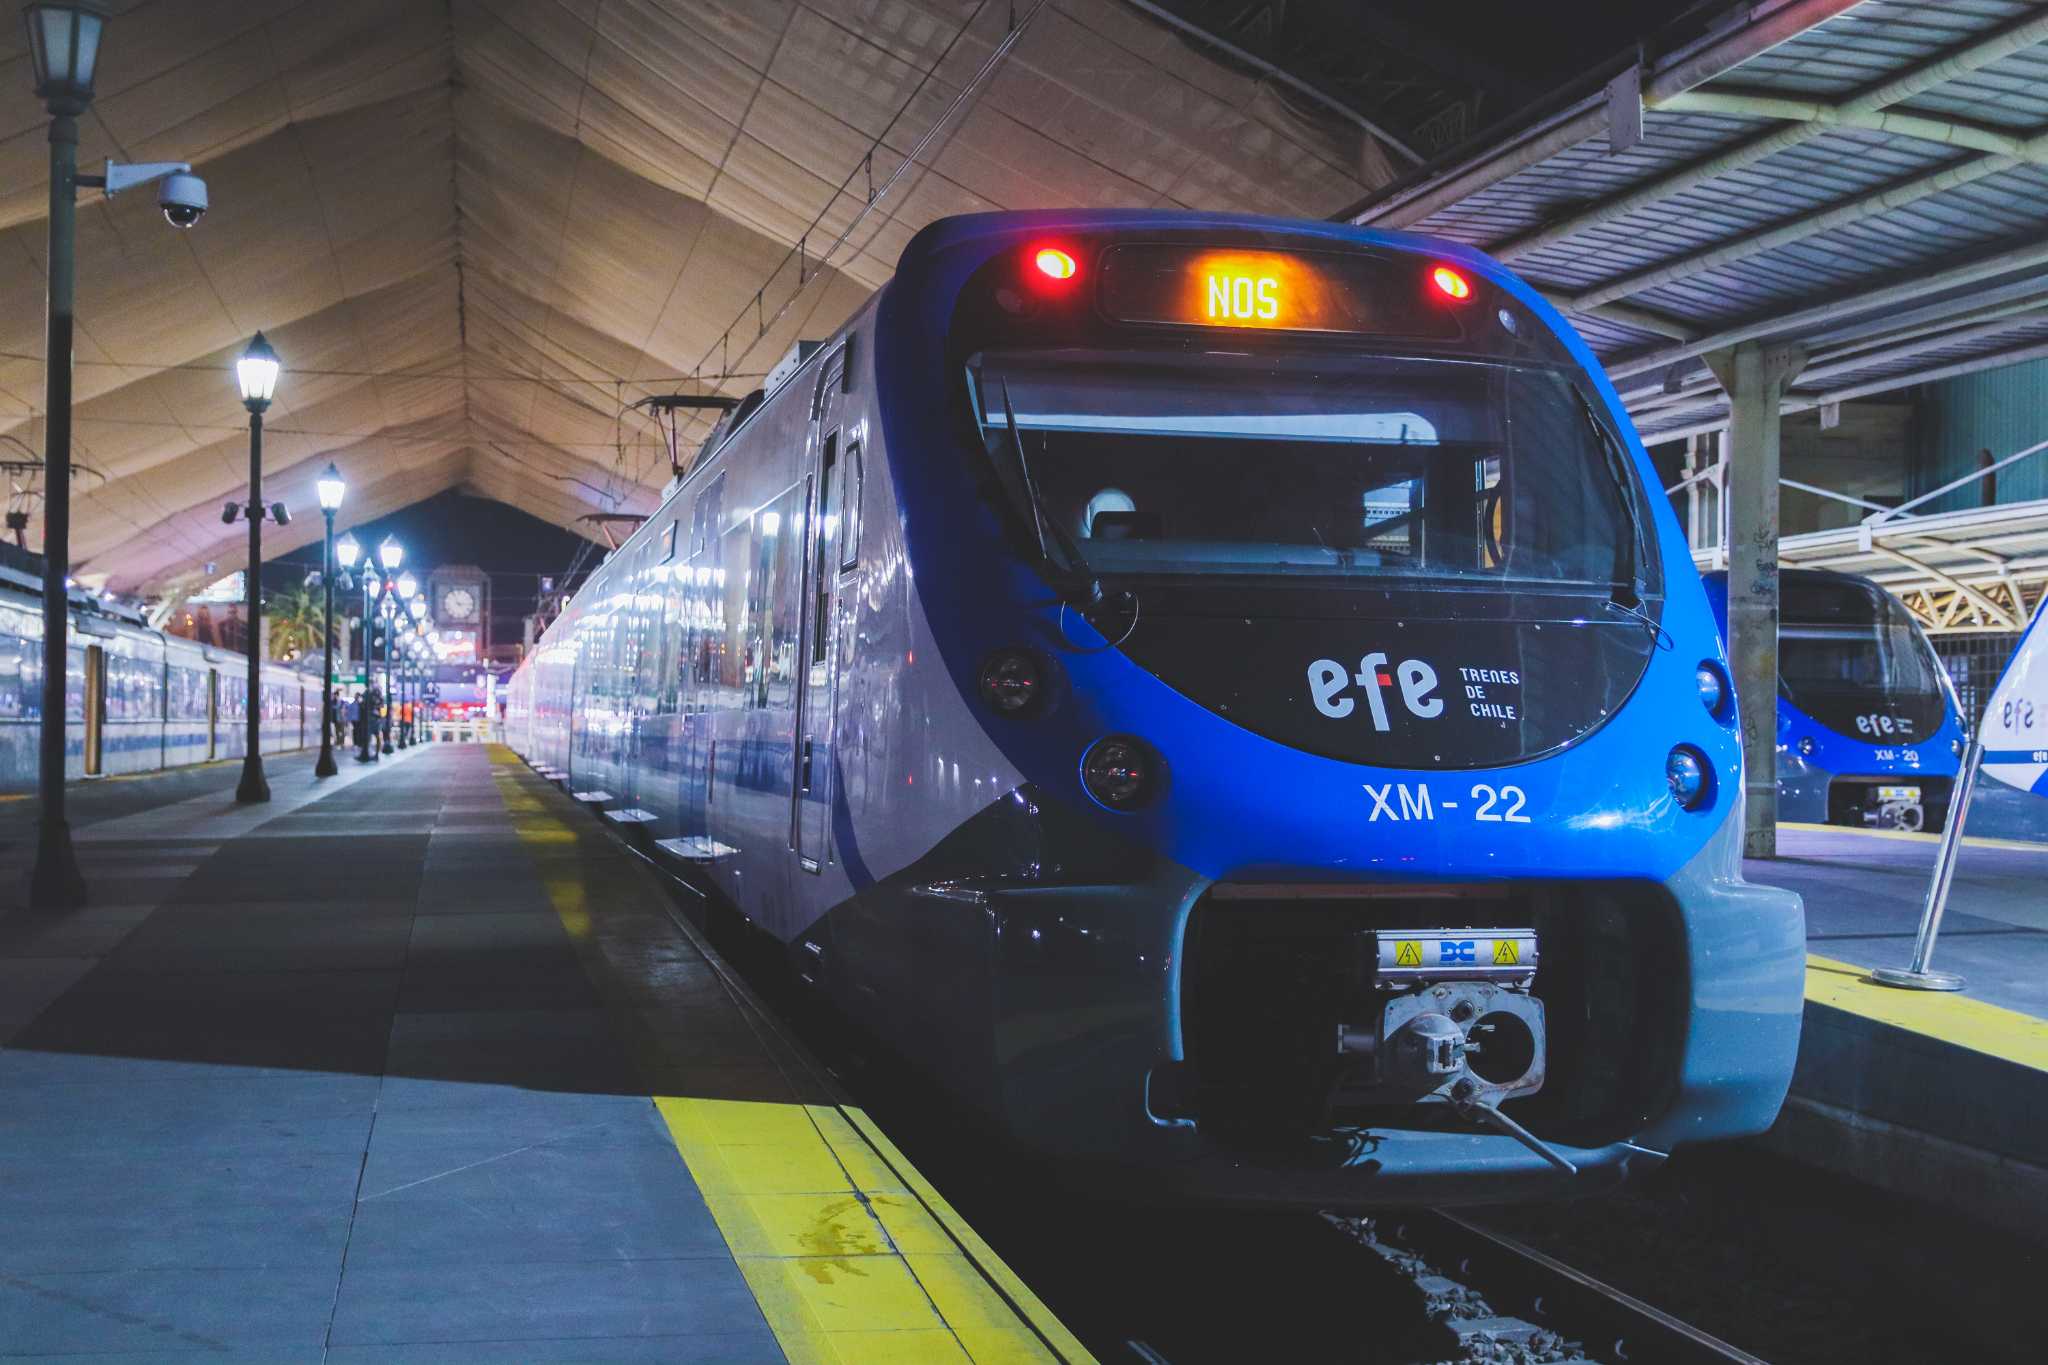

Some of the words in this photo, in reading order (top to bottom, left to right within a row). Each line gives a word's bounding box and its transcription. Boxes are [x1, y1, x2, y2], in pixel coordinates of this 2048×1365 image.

[1208, 274, 1278, 319] NOS
[1459, 667, 1520, 685] TRENES
[1307, 652, 1444, 731] efe
[1465, 685, 1486, 699] DE
[1470, 703, 1517, 720] CHILE
[1855, 713, 1895, 737] efe
[1470, 784, 1531, 823] 22
